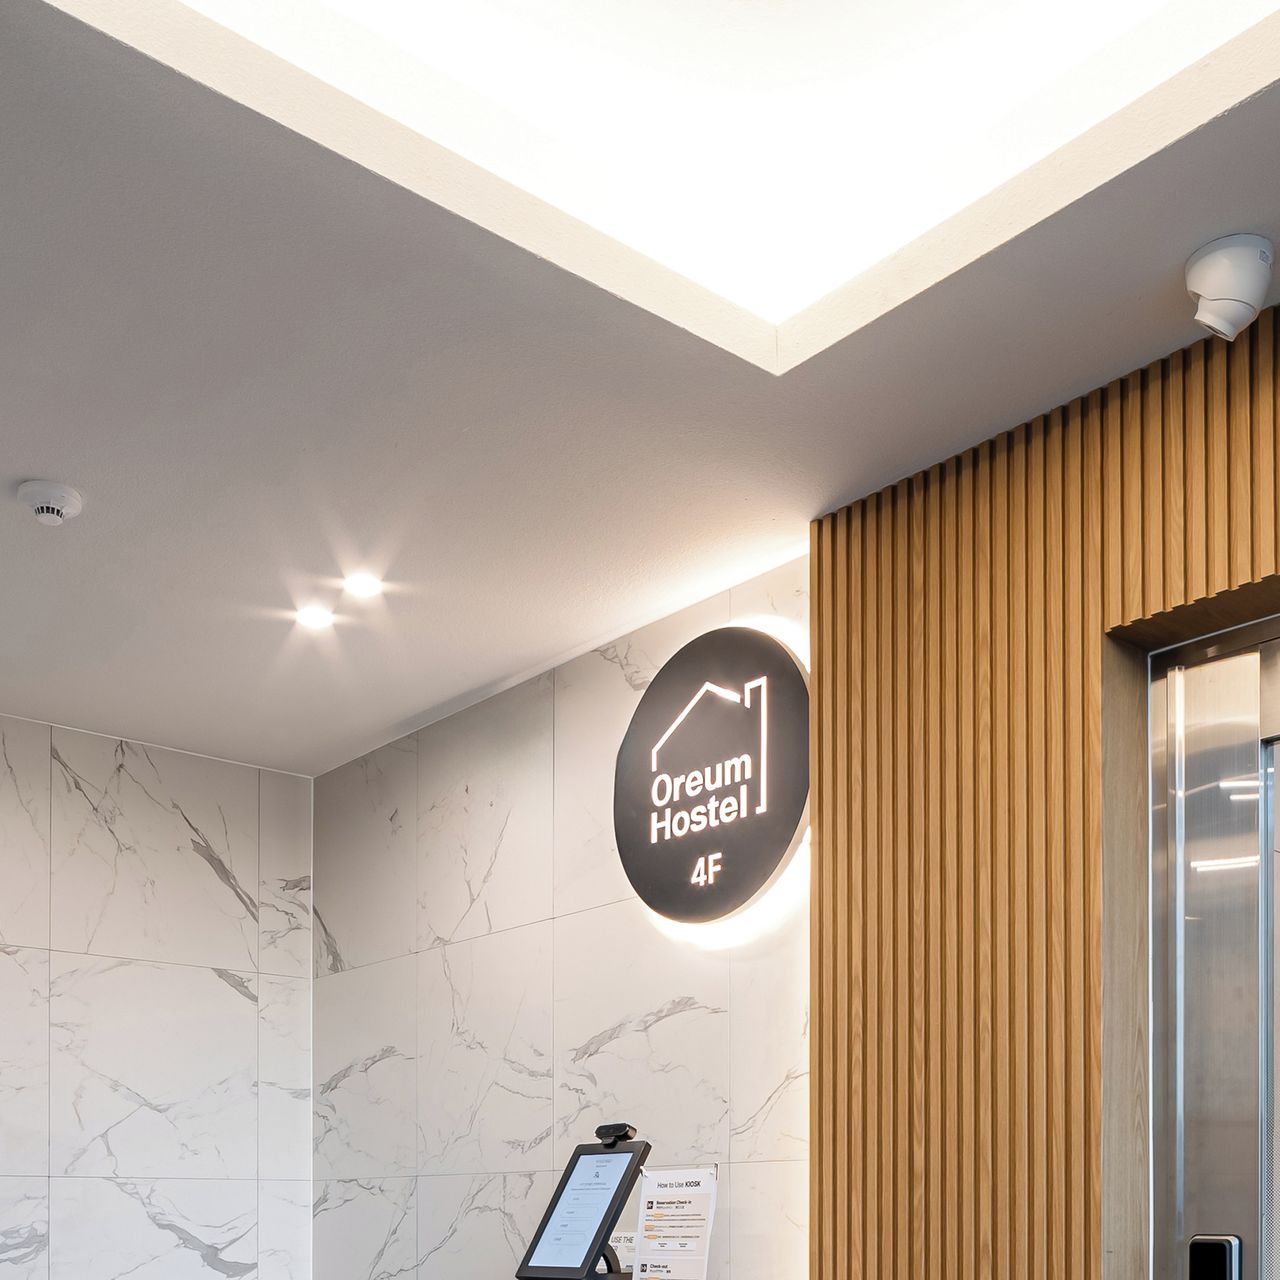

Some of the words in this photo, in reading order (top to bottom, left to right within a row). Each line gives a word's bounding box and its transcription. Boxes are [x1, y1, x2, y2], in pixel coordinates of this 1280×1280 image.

[650, 752, 752, 807] Oreum
[650, 784, 748, 844] Hostel
[690, 851, 723, 887] 4F
[685, 1180, 702, 1188] KIOSK
